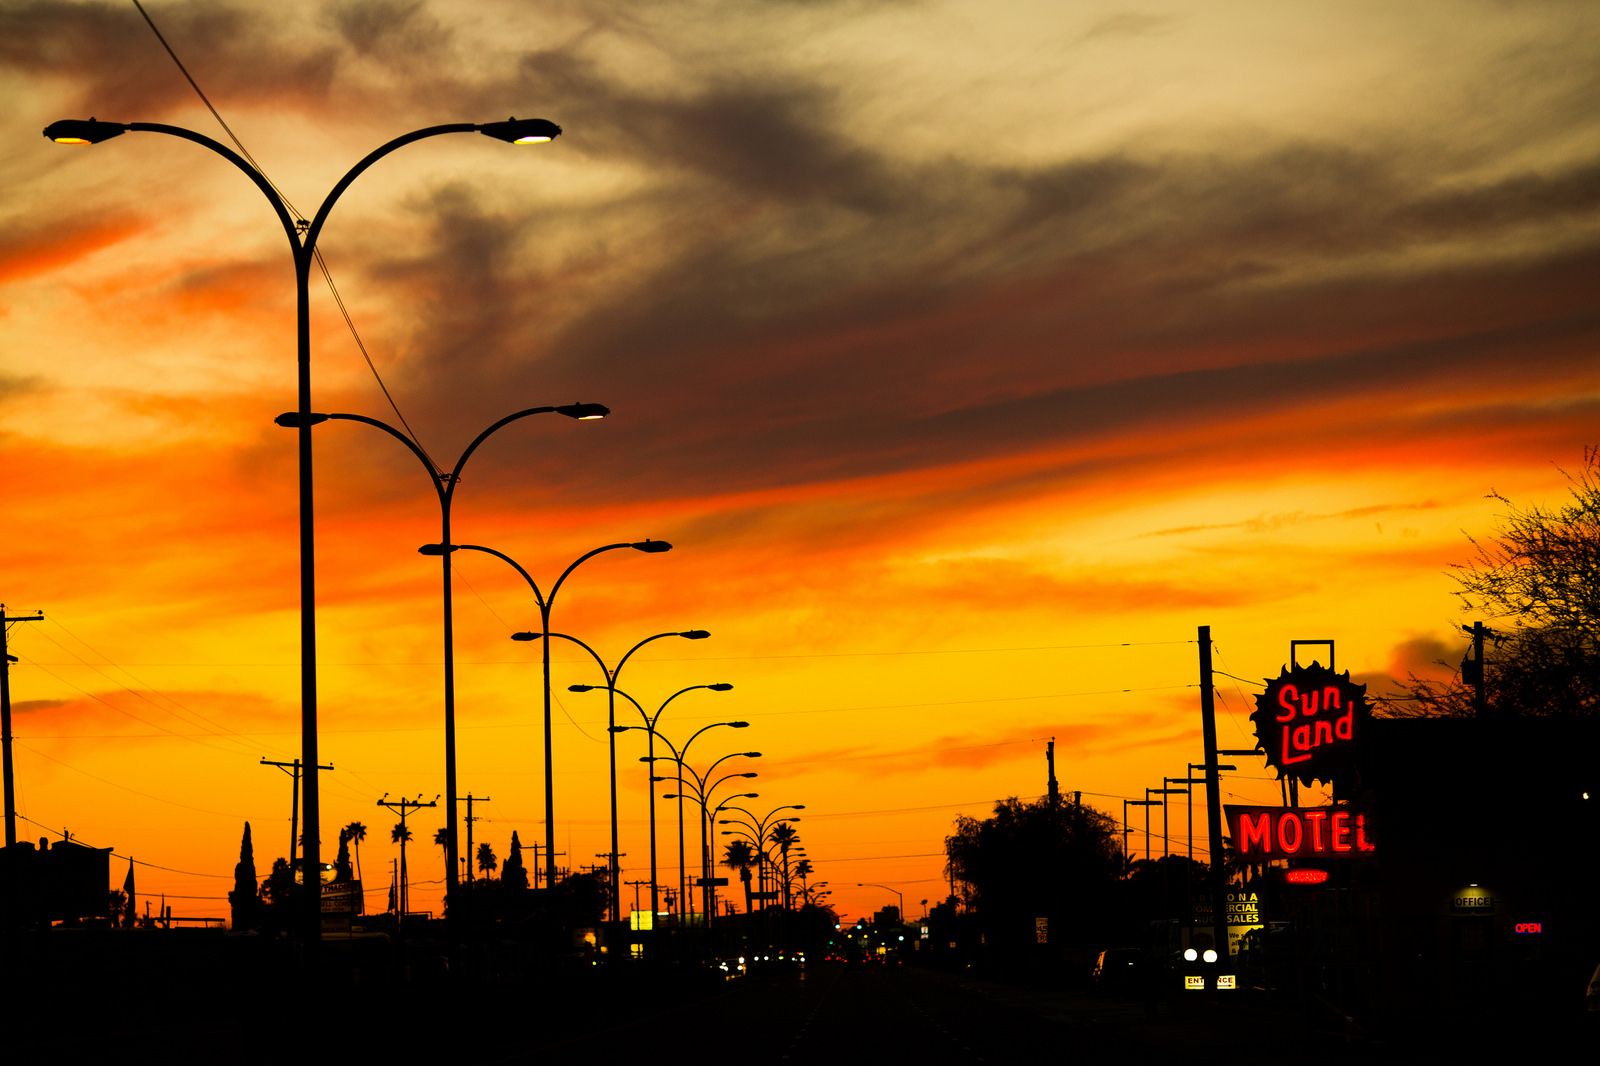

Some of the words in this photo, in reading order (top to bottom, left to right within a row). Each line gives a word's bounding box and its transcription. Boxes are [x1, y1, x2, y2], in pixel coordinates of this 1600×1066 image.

[1275, 682, 1342, 723] Sun
[1281, 699, 1355, 765] Land
[1238, 811, 1376, 855] MOTEL
[1455, 897, 1489, 906] OFFICE
[1226, 914, 1260, 923] SALES
[1515, 923, 1542, 934] OPEN
